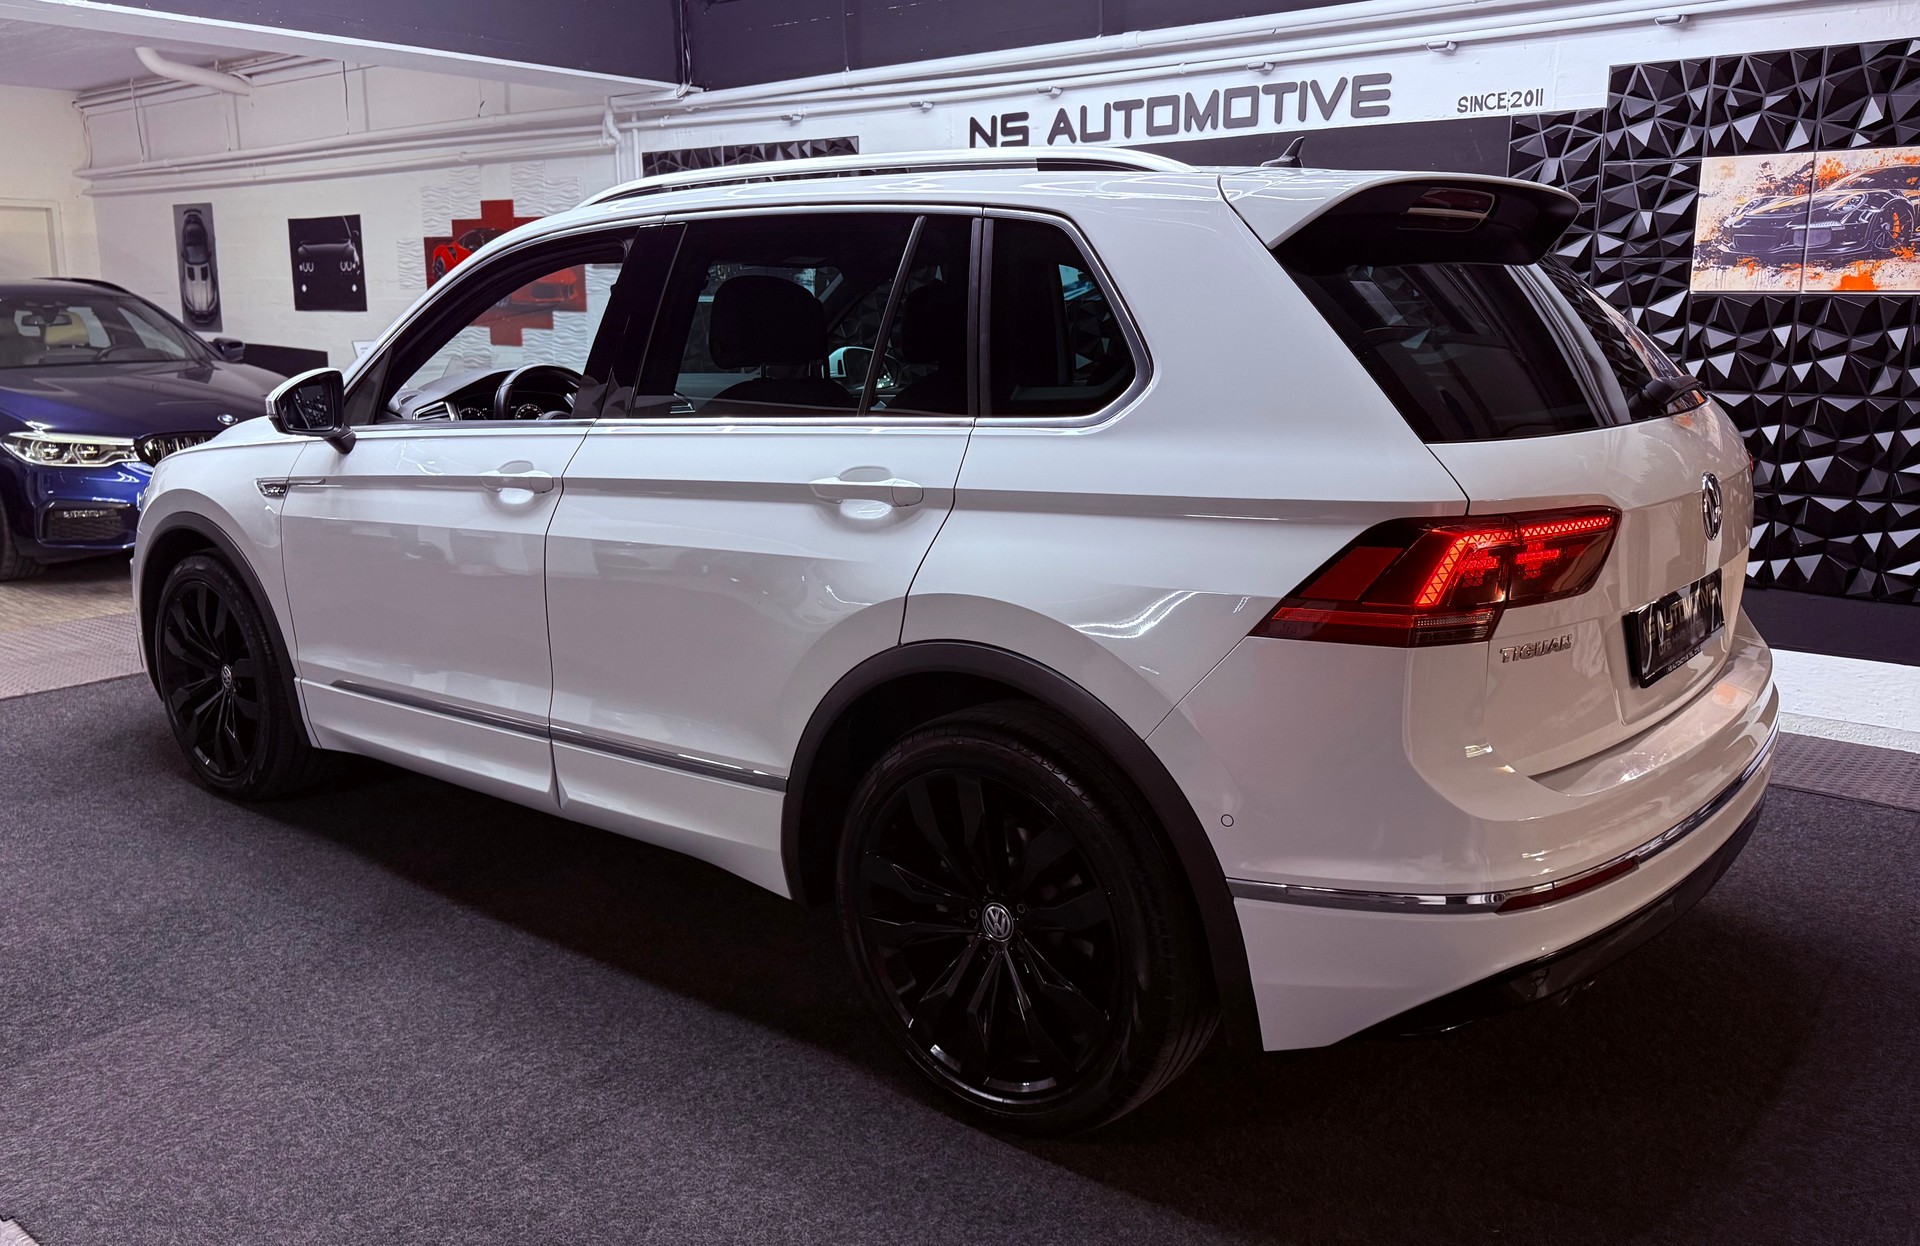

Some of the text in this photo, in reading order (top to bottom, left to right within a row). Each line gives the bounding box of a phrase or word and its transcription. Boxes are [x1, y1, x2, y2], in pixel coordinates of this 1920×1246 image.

[970, 73, 1392, 148] NS AUTOMOTIVE
[1500, 634, 1572, 663] TIGUAN
